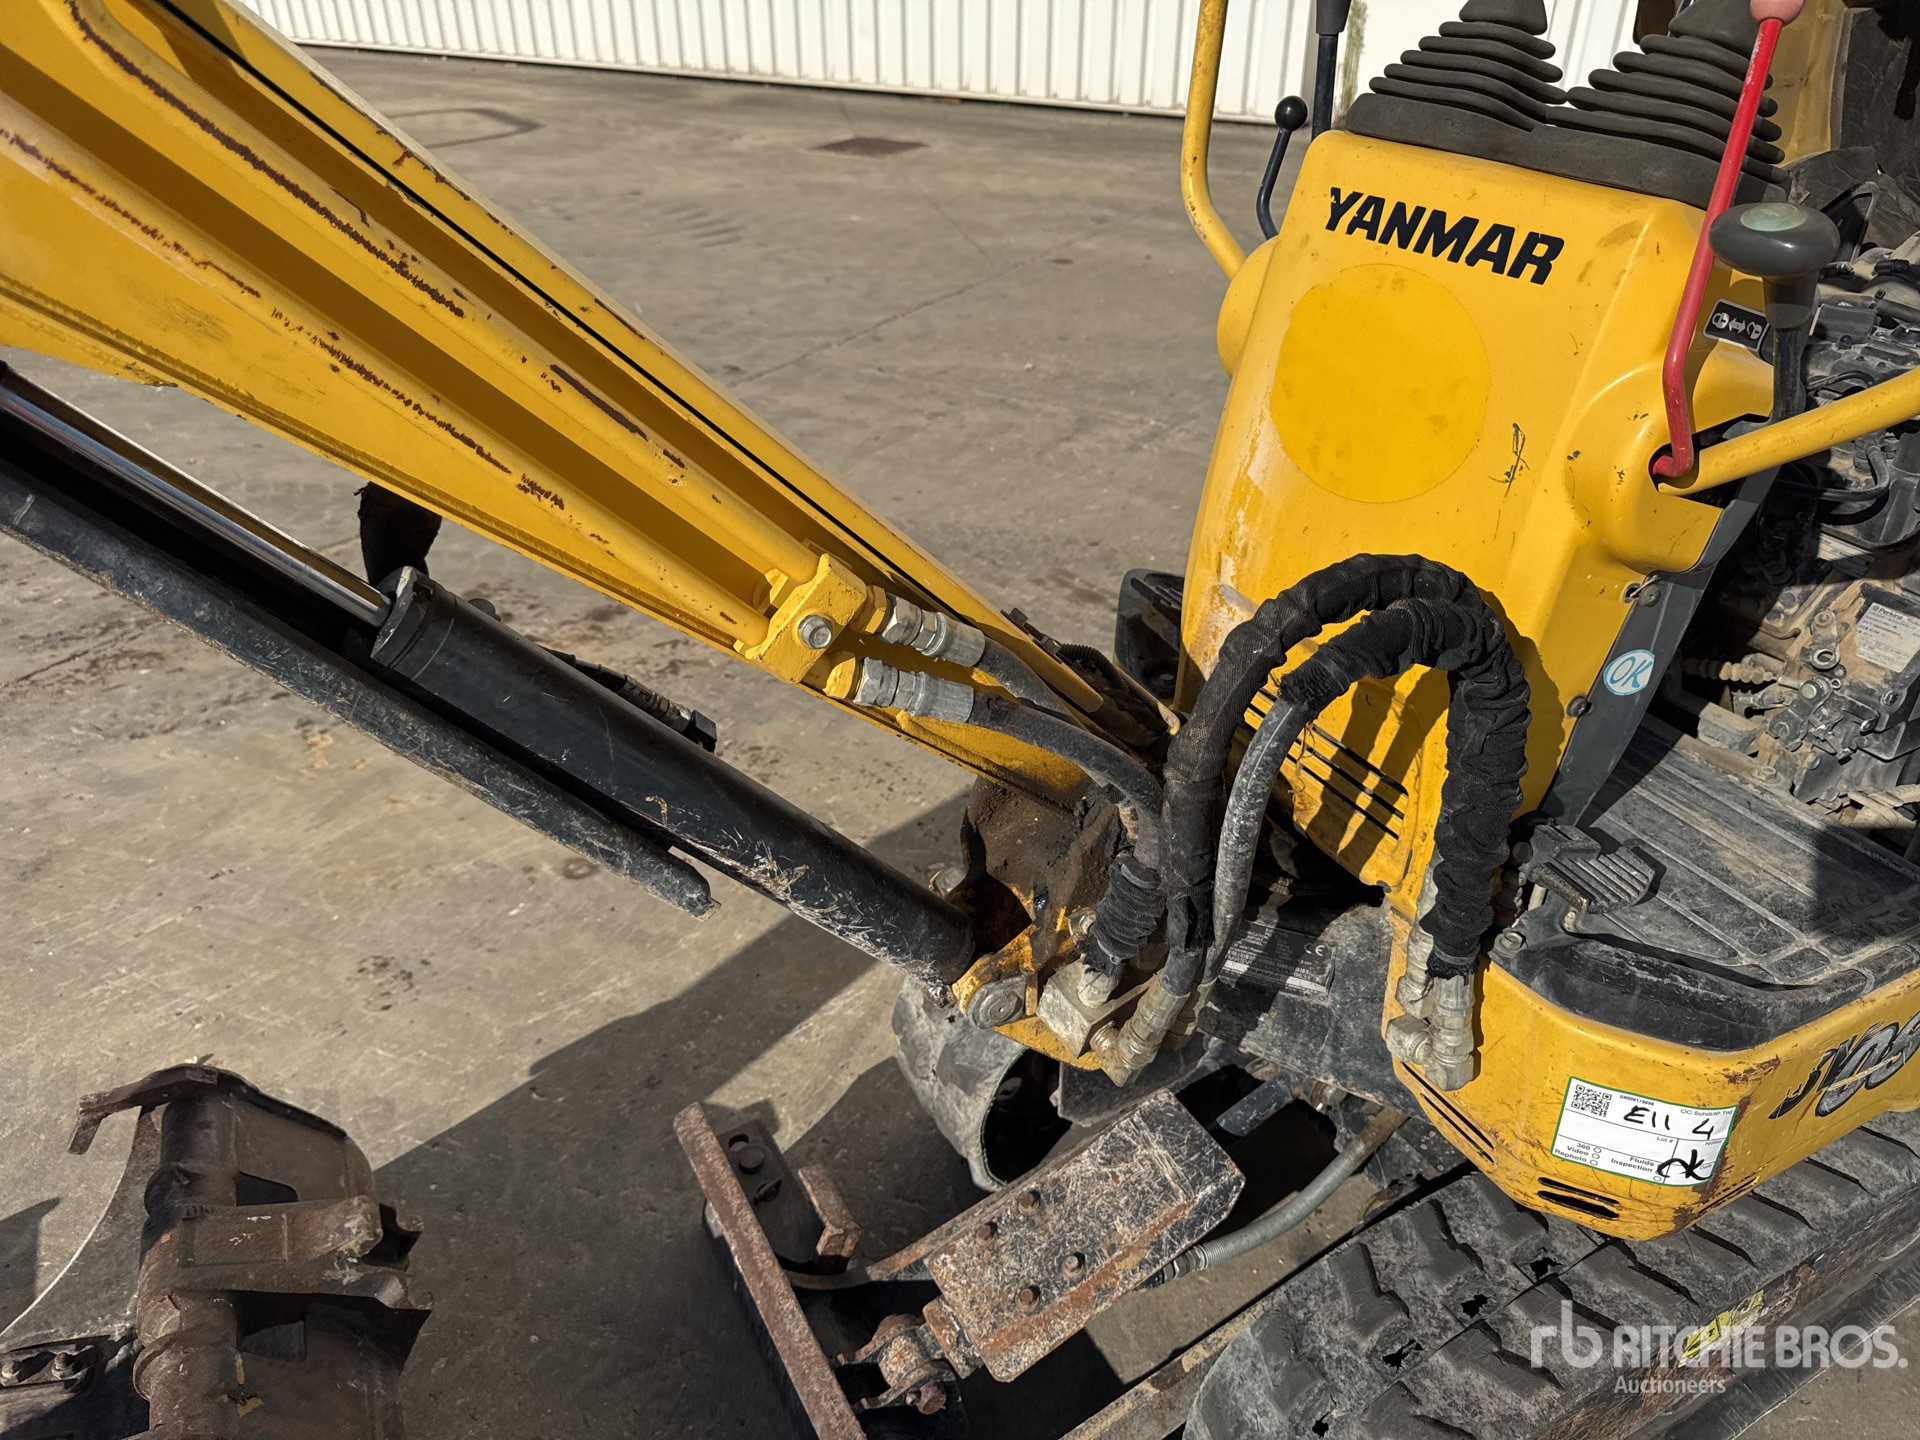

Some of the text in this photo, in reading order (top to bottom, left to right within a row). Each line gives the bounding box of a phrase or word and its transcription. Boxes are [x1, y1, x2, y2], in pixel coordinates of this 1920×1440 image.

[1325, 187, 1565, 286] YANMAR
[1879, 607, 1904, 621] Perkins
[1609, 656, 1653, 689] OK
[1566, 1145, 1589, 1157] Video
[1576, 1142, 1591, 1151] 360
[1554, 1148, 1587, 1163] Rephoto
[1629, 1156, 1654, 1167] Fluids
[1611, 1158, 1653, 1173] Inspection
